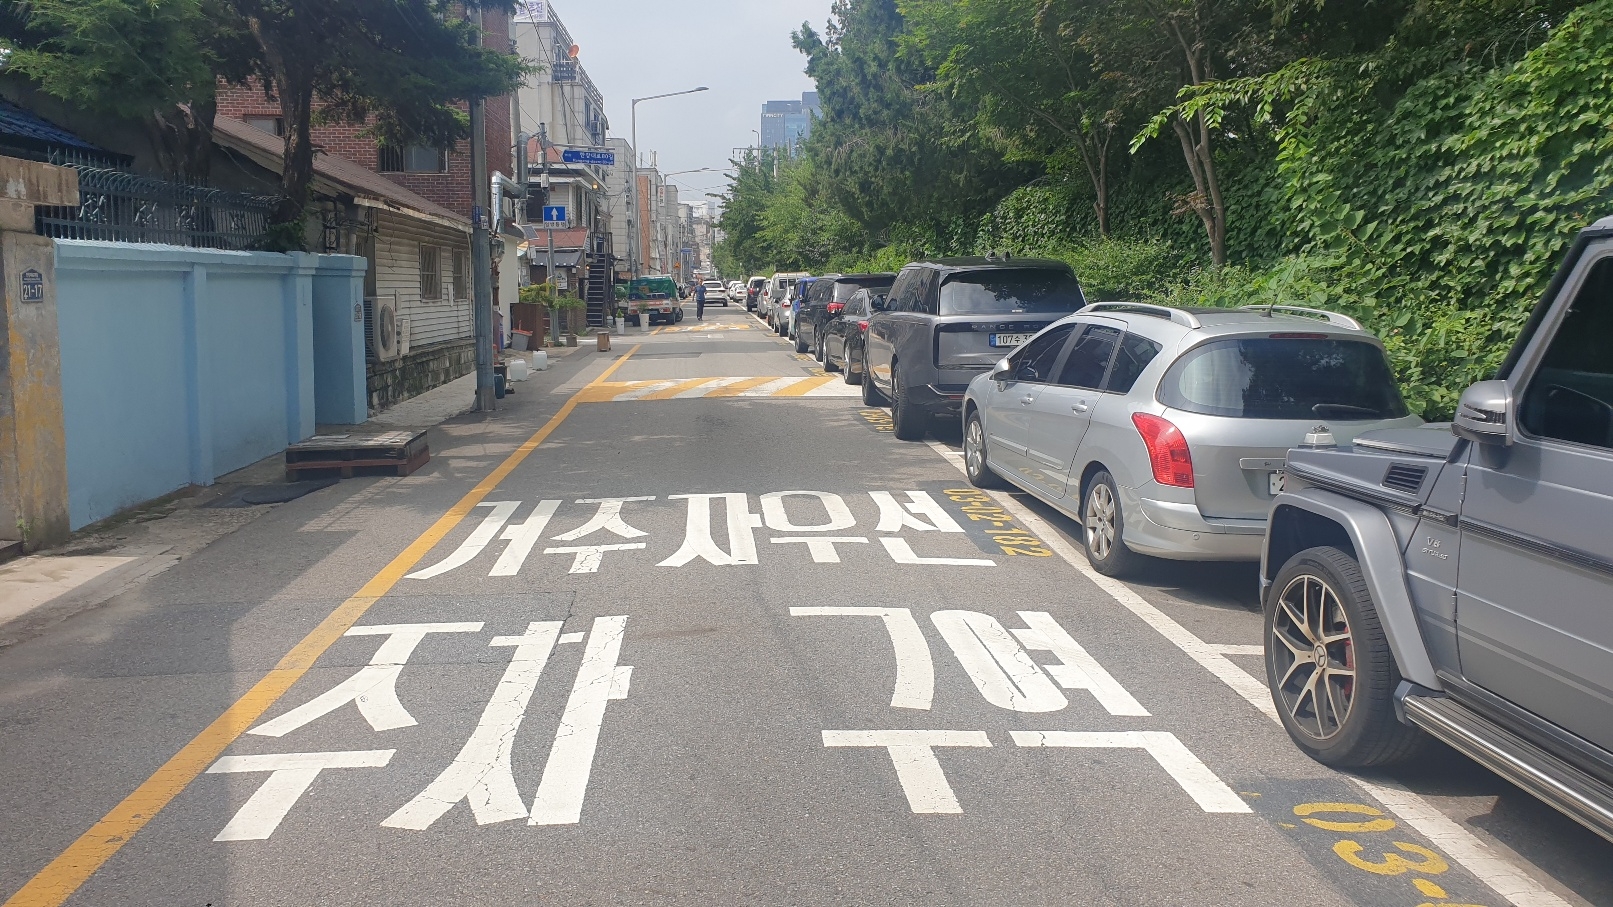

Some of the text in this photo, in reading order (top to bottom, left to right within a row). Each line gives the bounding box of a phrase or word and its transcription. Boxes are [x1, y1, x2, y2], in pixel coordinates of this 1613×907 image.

[23, 284, 43, 298] 21-17
[403, 489, 998, 580] 거주자우선
[943, 488, 1053, 557] 03-02-182
[206, 605, 1254, 843] 주차 구역
[1292, 801, 1489, 907] 03-
